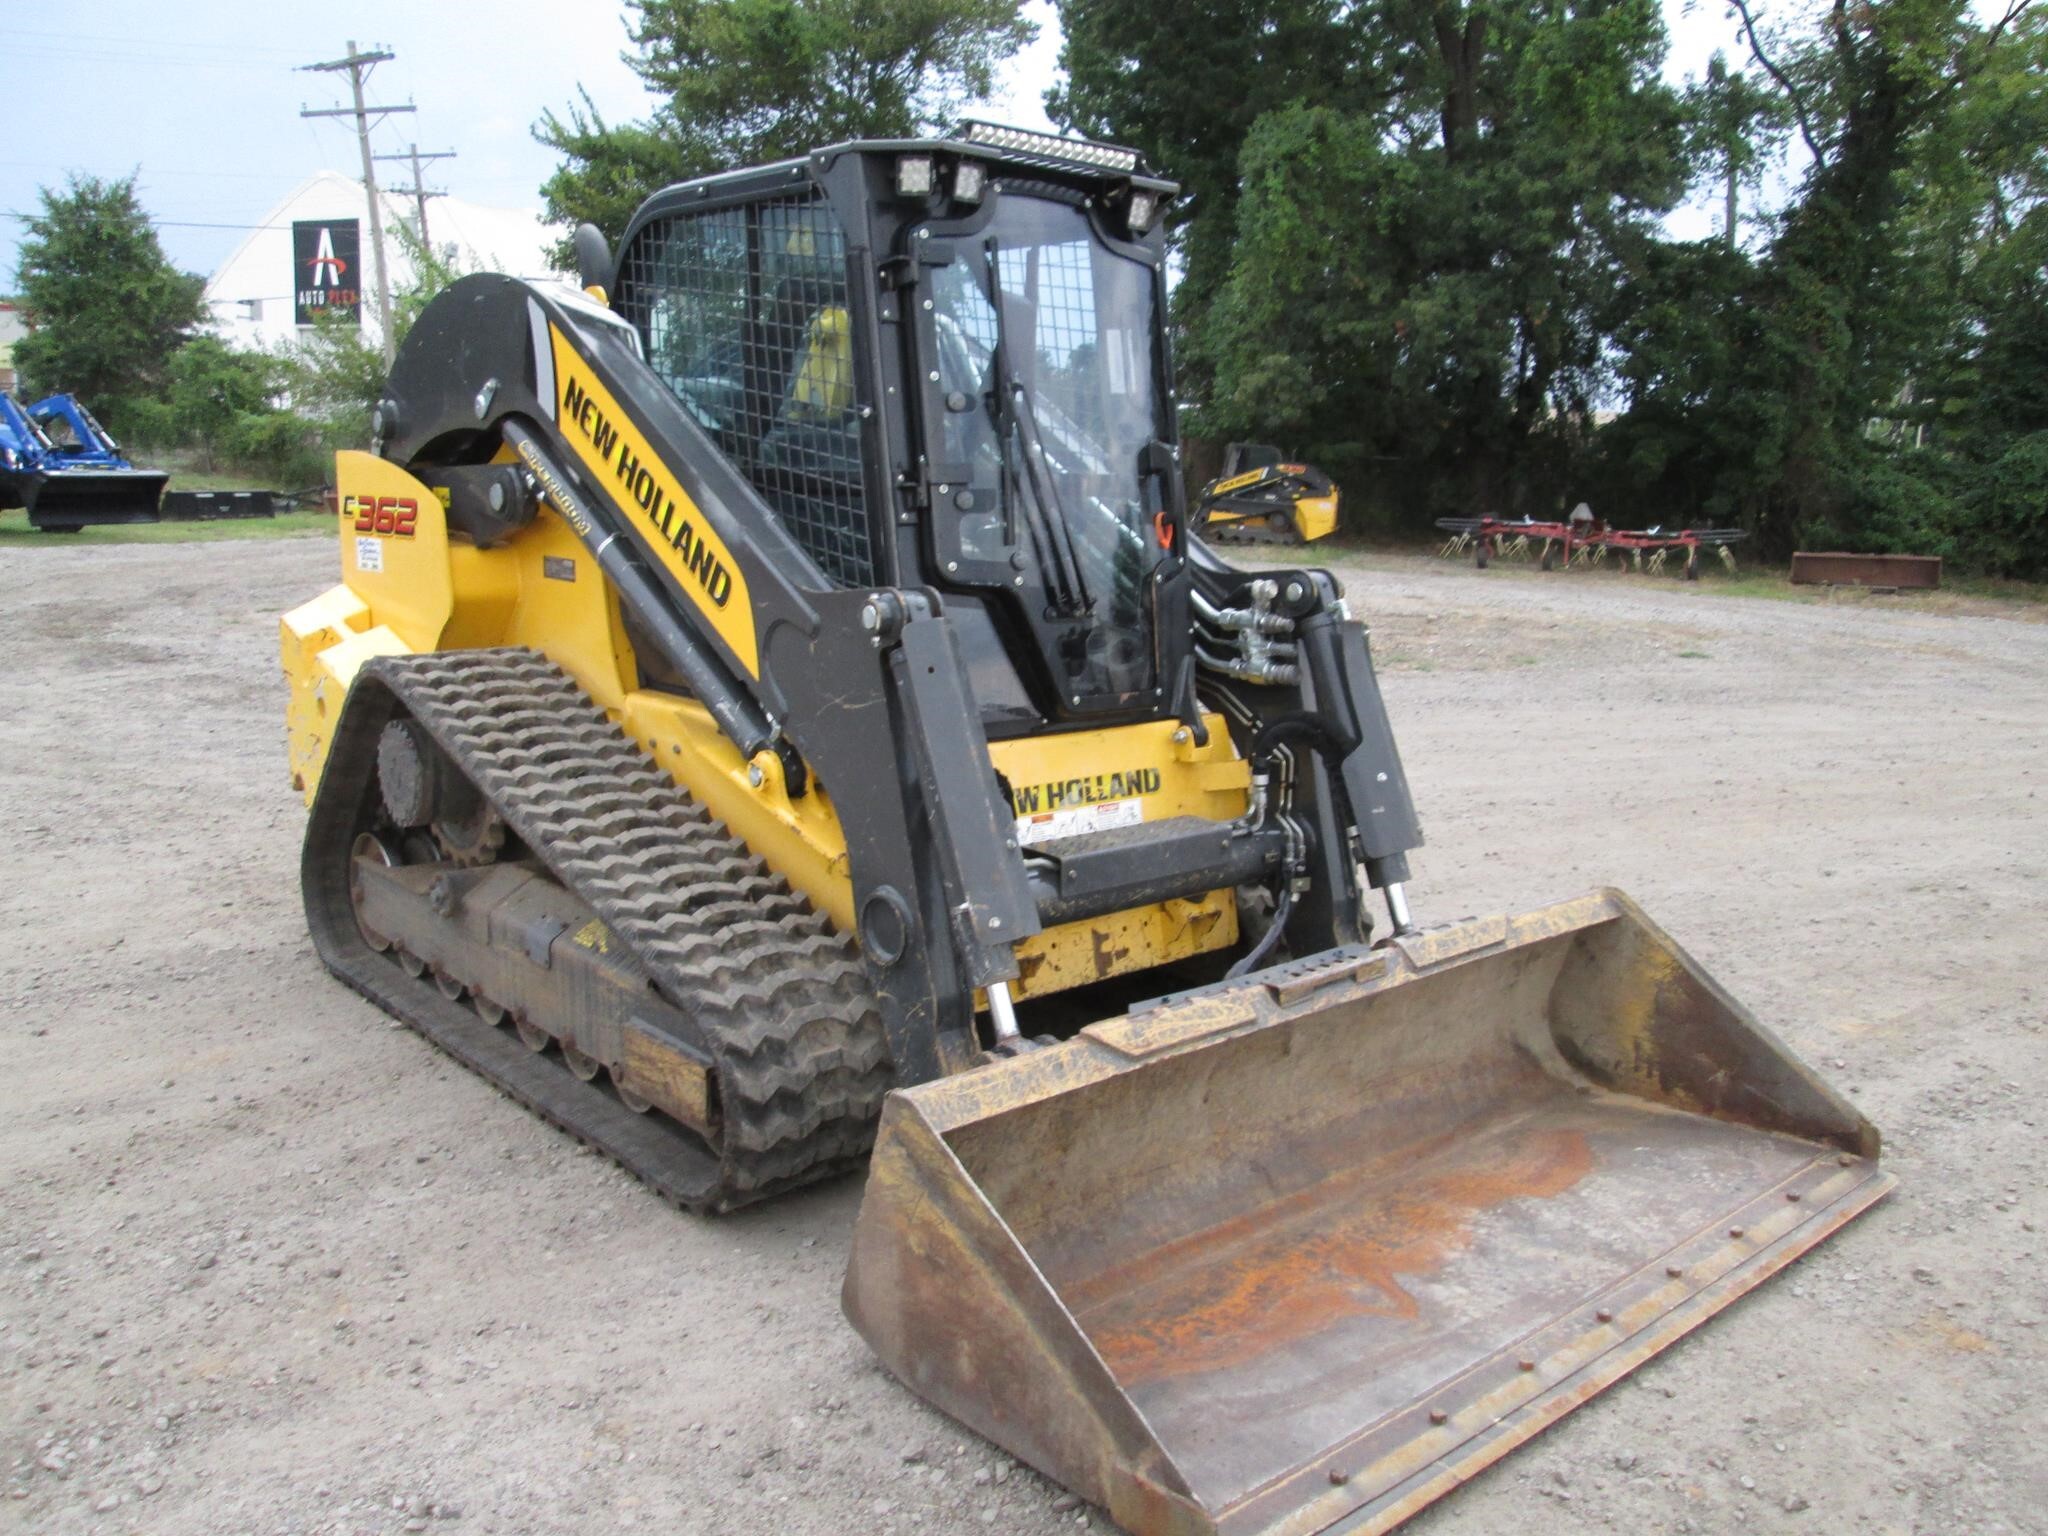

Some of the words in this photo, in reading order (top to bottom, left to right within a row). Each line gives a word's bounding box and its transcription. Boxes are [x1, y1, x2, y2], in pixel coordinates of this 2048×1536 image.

[298, 290, 325, 305] AUTO
[563, 375, 618, 459] NEW
[616, 442, 733, 608] HOLLAND
[1046, 768, 1161, 809] HOLLAND
